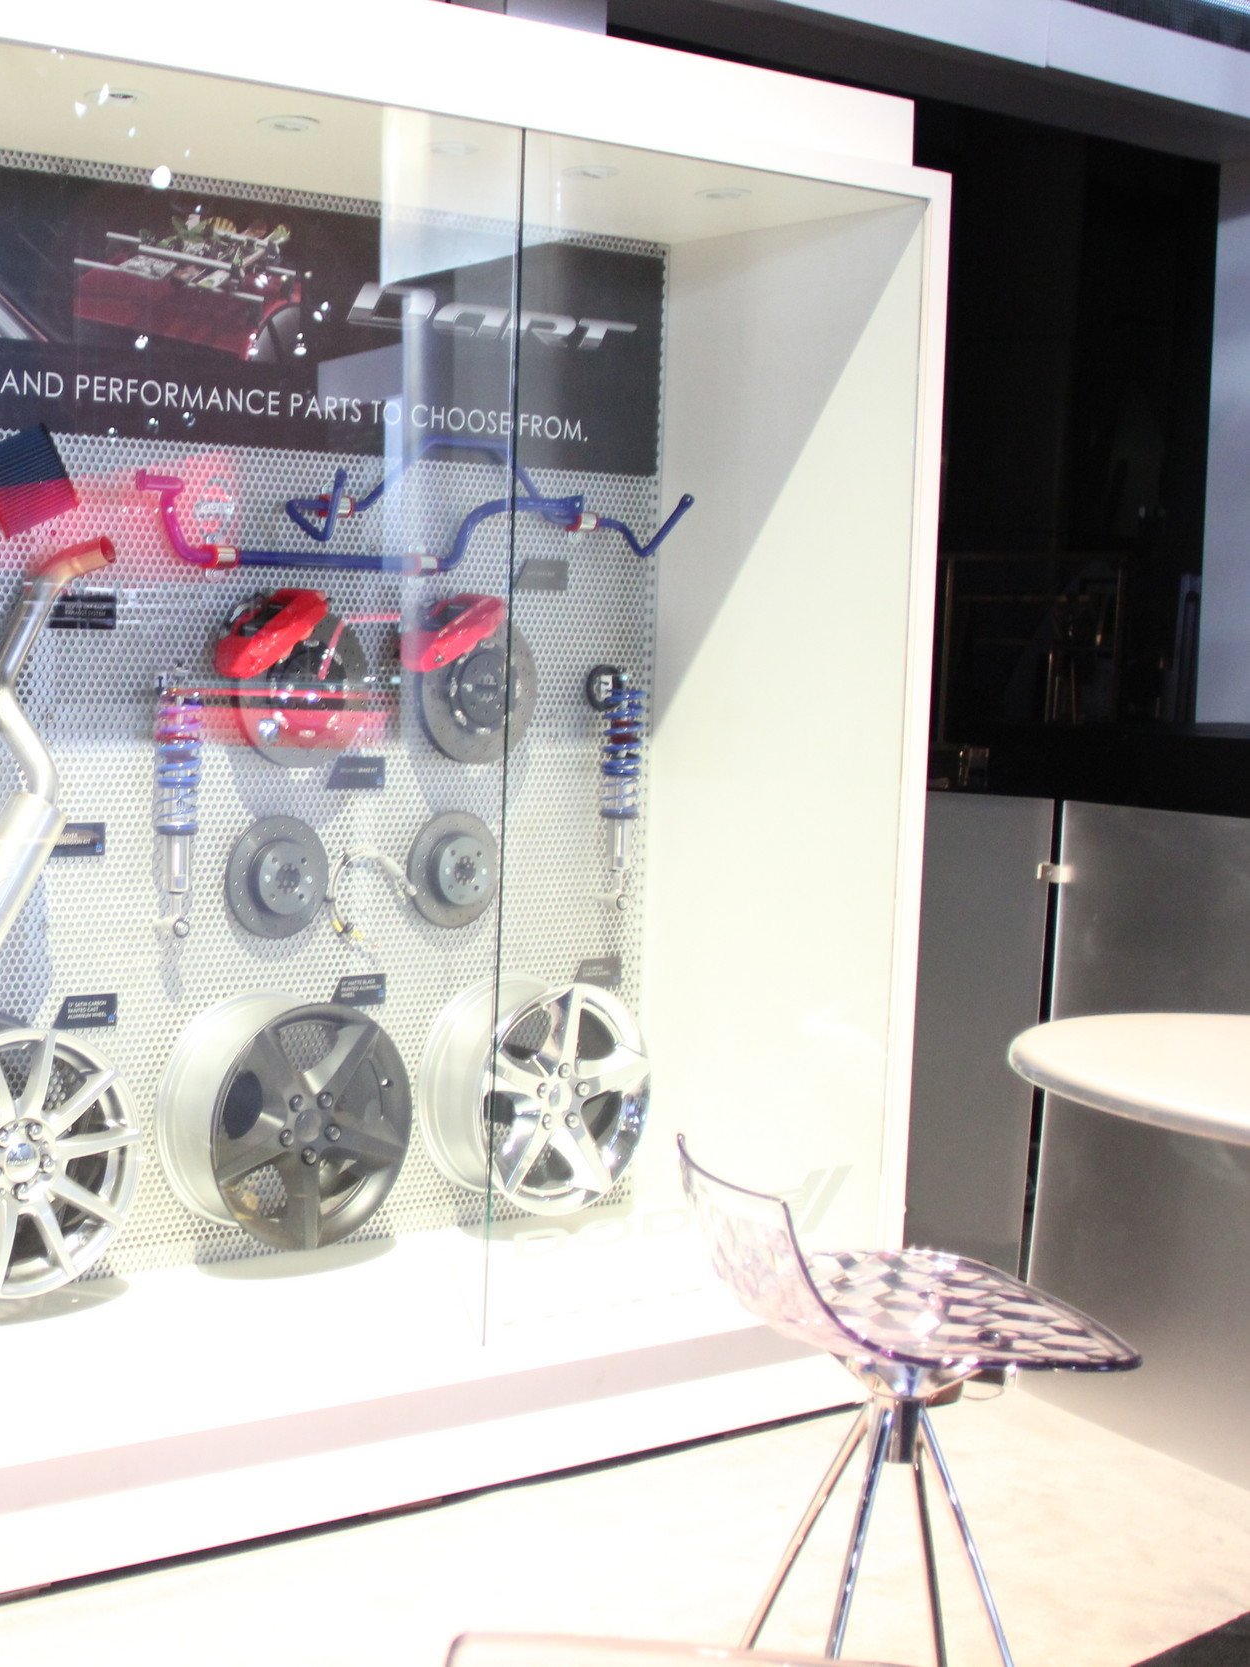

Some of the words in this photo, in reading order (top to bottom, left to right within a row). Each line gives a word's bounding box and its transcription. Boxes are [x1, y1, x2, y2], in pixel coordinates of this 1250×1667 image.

[0, 368, 64, 399] AND
[76, 374, 281, 416] PERFORMANCE
[290, 393, 363, 423] PARTS
[370, 400, 402, 427] TO
[411, 403, 513, 435] CHOOSE
[519, 413, 589, 443] FROM.
